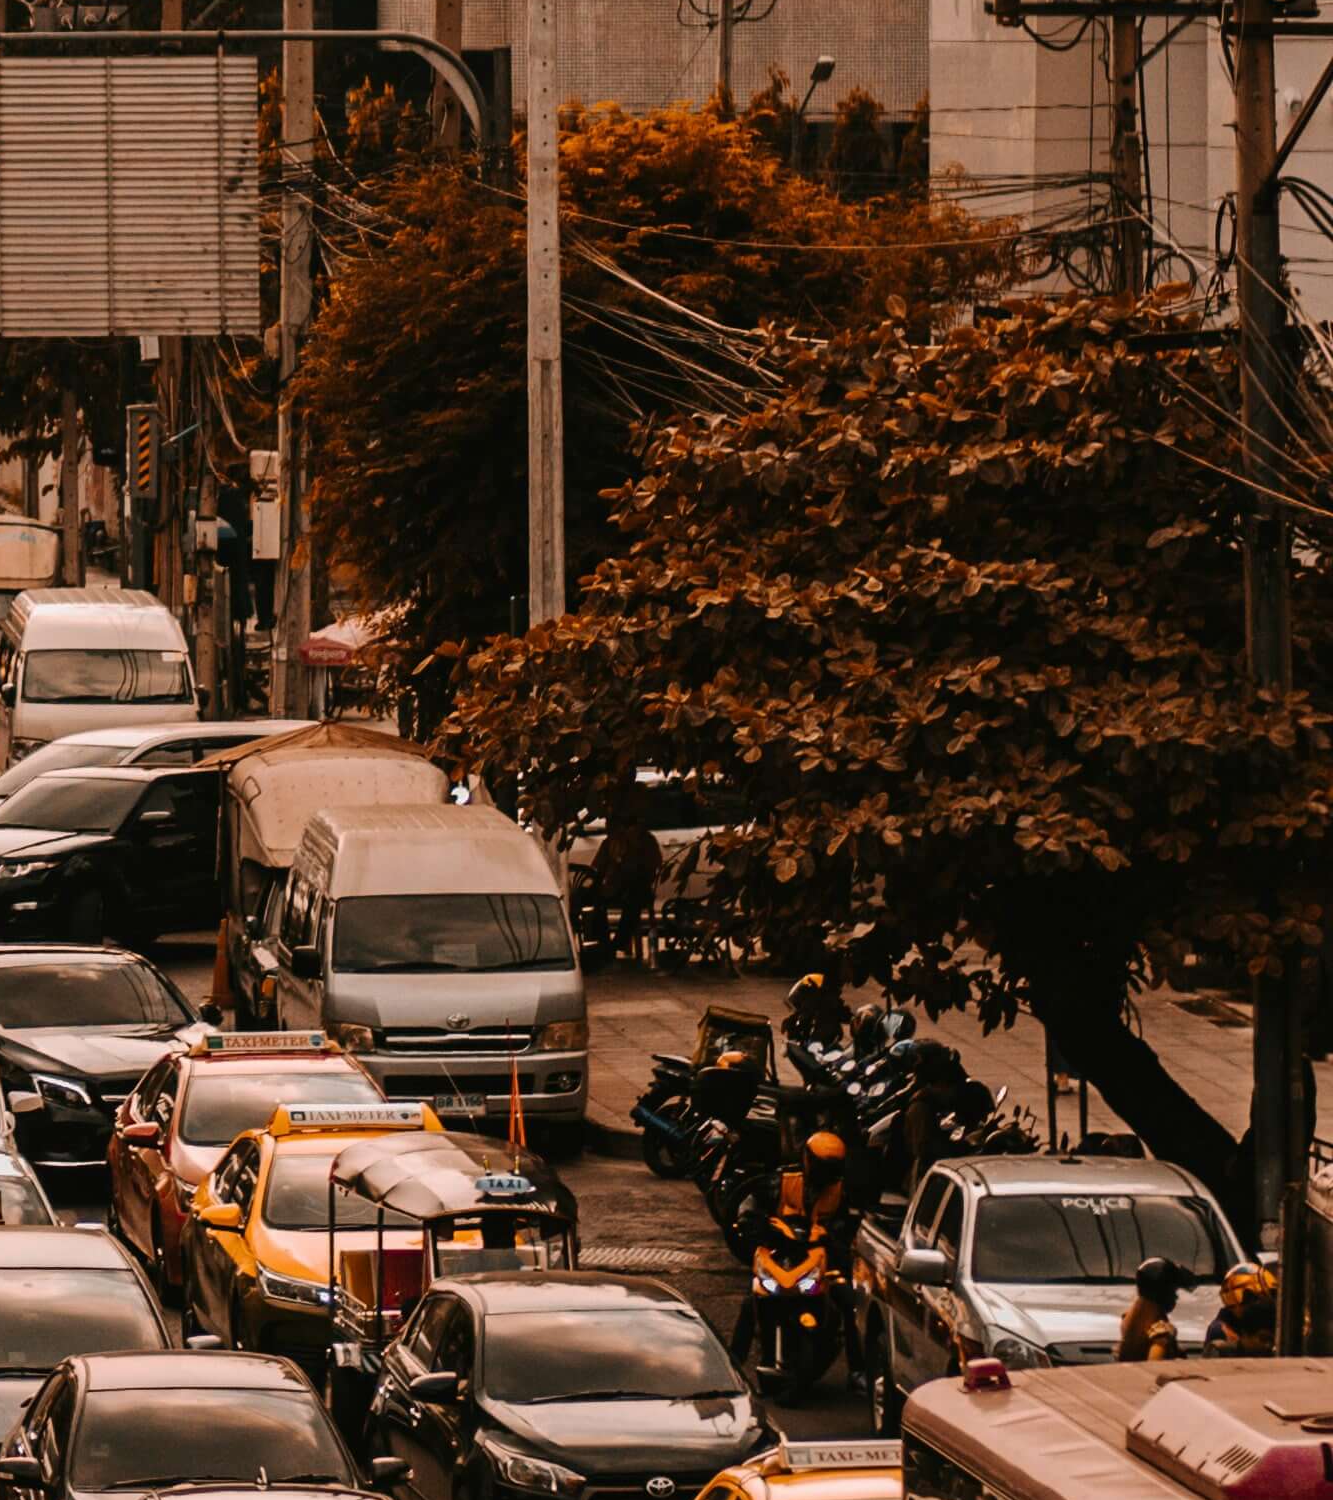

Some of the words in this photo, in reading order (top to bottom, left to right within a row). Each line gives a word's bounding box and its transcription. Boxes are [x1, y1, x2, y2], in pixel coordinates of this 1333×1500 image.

[223, 1035, 309, 1049] TAXI-METER
[309, 1109, 396, 1121] TAXI-METER
[488, 1178, 523, 1190] TAXI
[1060, 1197, 1131, 1209] POLICE
[818, 1447, 901, 1463] TAXI-MET
